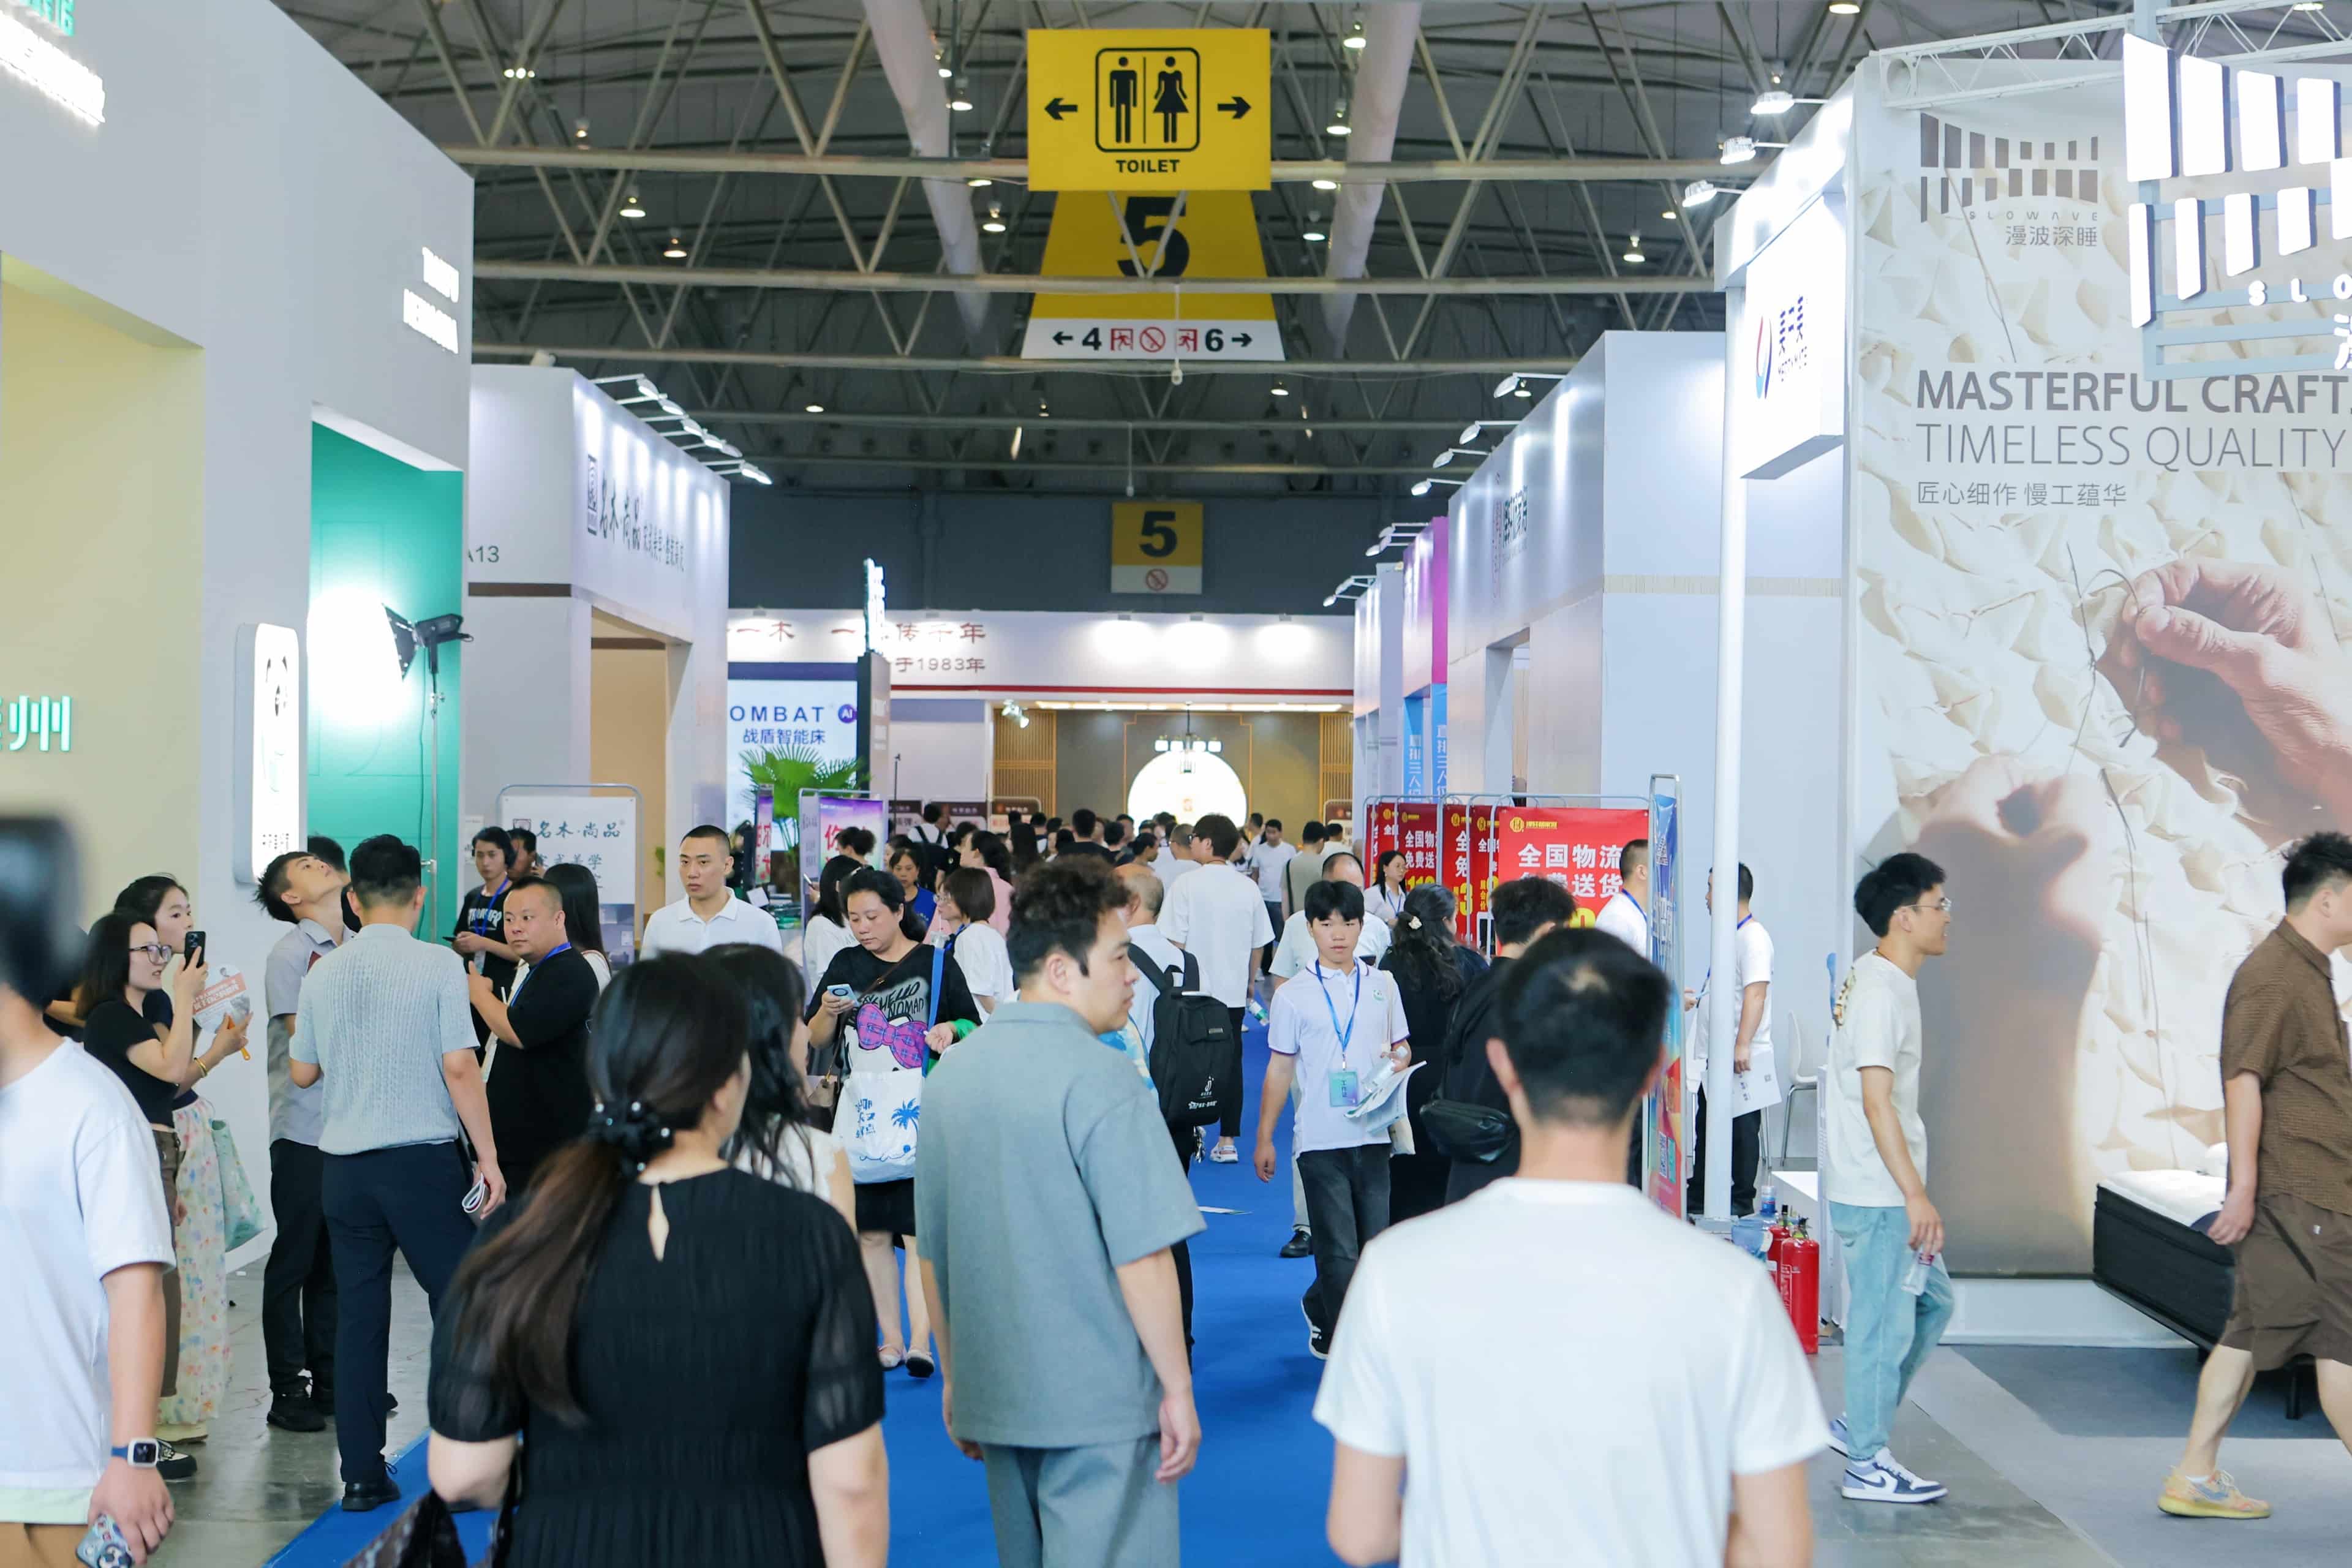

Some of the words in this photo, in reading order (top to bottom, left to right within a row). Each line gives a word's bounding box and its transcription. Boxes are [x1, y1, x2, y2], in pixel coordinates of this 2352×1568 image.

[1116, 160, 1180, 173] TOILET
[1117, 197, 1189, 277] 5
[2005, 225, 2098, 246] 漫波深睡
[1082, 327, 1102, 351] 4
[1205, 329, 1224, 352] 6
[1917, 369, 2188, 413] MASTERFUL
[2201, 374, 2352, 415] CRAFT
[1915, 424, 2130, 466] TIMELESS
[2146, 426, 2346, 472] QUALITY
[1918, 481, 2018, 506] 匠心细作
[2024, 482, 2127, 507] 慢工蕴华
[1139, 511, 1178, 557] 5
[0, 695, 72, 752] 州
[729, 706, 824, 723] OMBAT
[743, 728, 826, 745] 战盾智能床
[1405, 830, 1438, 848] 全国物
[1405, 851, 1438, 869] 免费送
[1518, 843, 1624, 869] 全国物流
[1520, 872, 1623, 899] 送货
